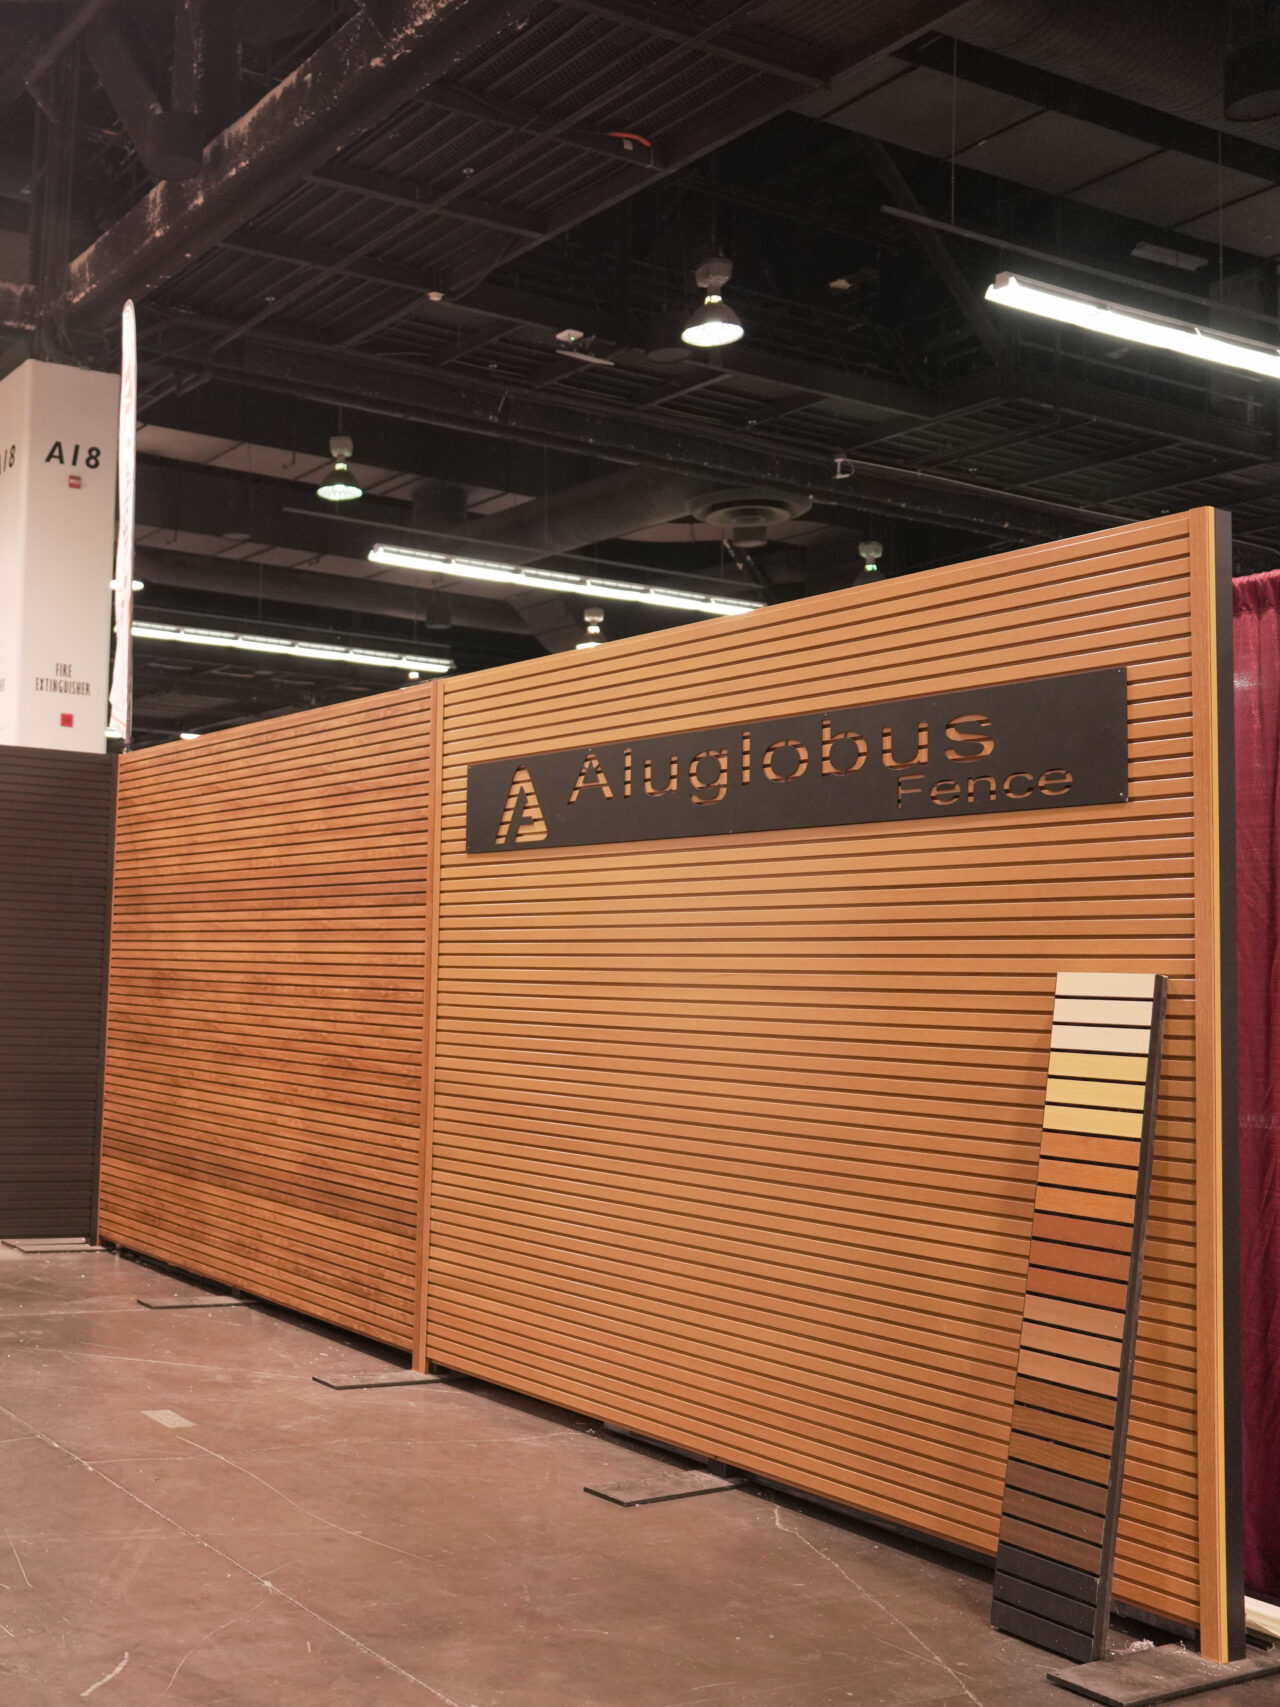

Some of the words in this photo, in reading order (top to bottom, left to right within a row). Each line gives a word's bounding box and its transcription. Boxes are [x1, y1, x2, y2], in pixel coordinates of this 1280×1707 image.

[44, 441, 101, 469] A18
[55, 662, 73, 678] FIRE
[35, 677, 91, 696] EXTINGUISHER
[568, 713, 996, 806] Aluglobus
[897, 767, 1074, 809] Fence
